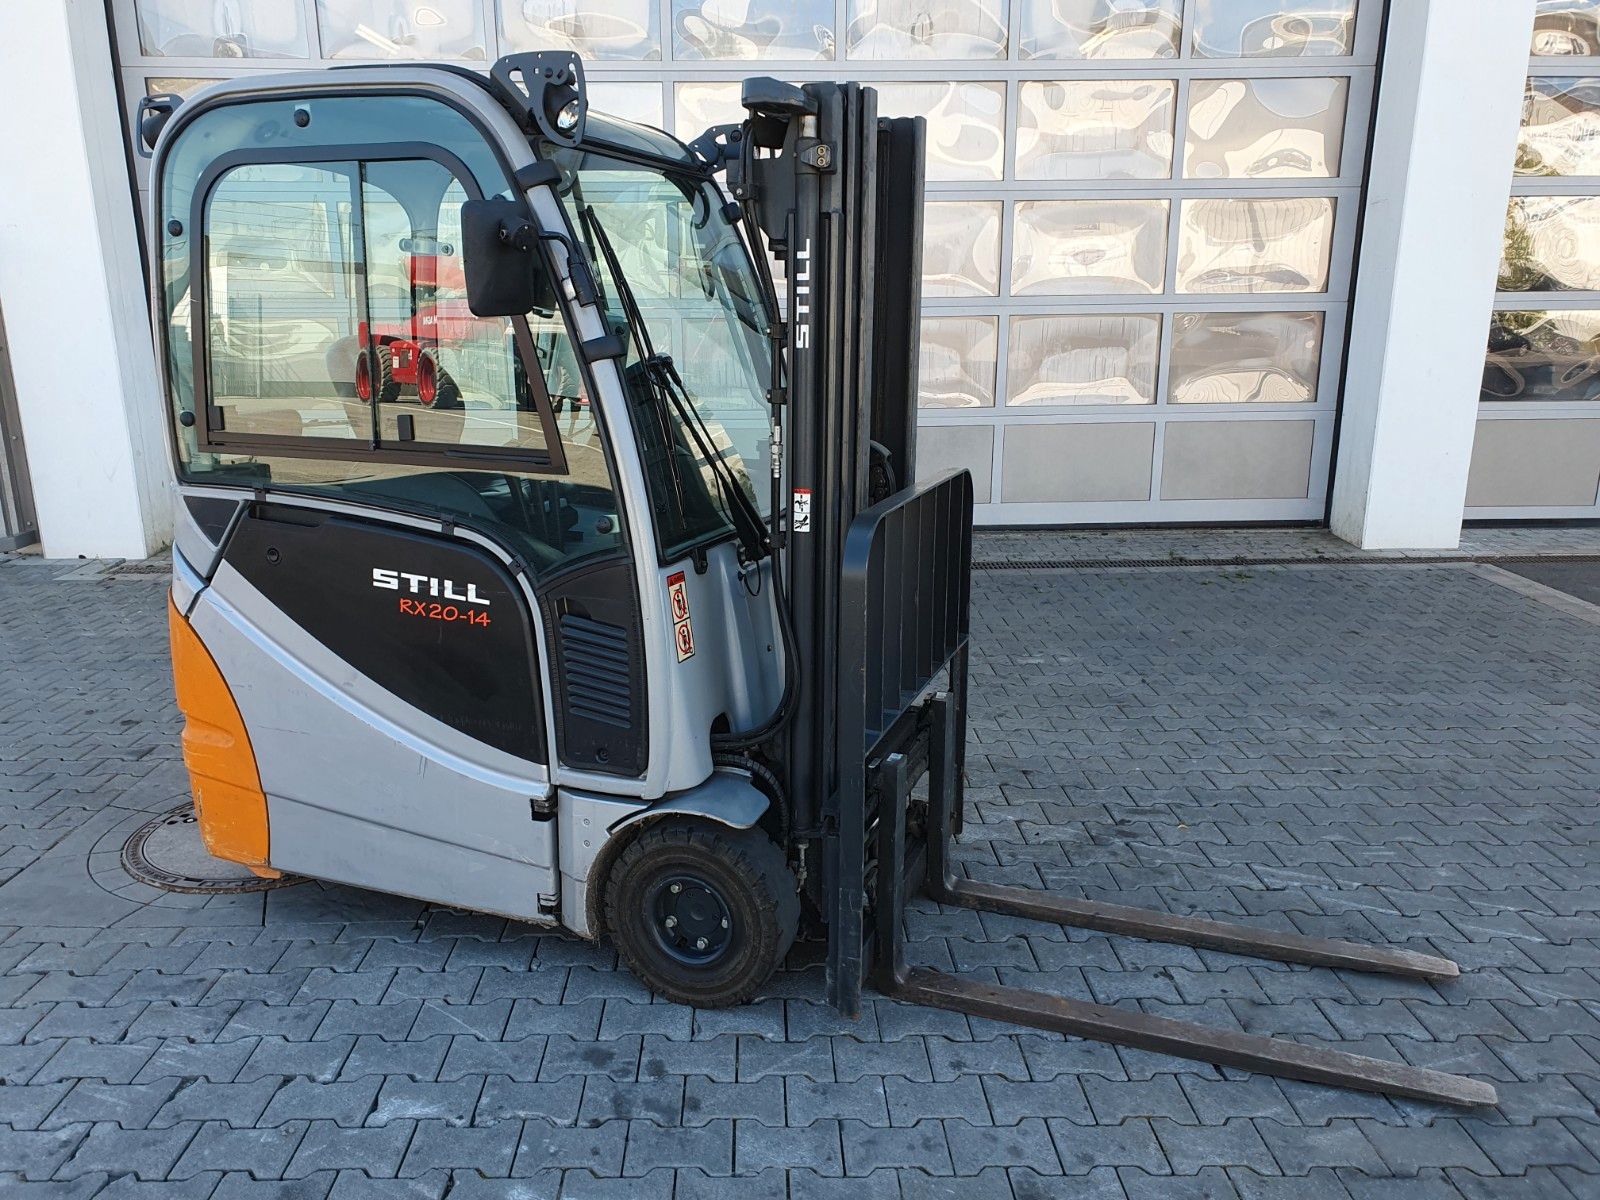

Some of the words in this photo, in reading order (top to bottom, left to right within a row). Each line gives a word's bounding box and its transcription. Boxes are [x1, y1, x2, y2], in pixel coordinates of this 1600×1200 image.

[796, 238, 810, 349] STILL
[372, 567, 491, 606] STILL
[400, 598, 491, 627] RX20-14
